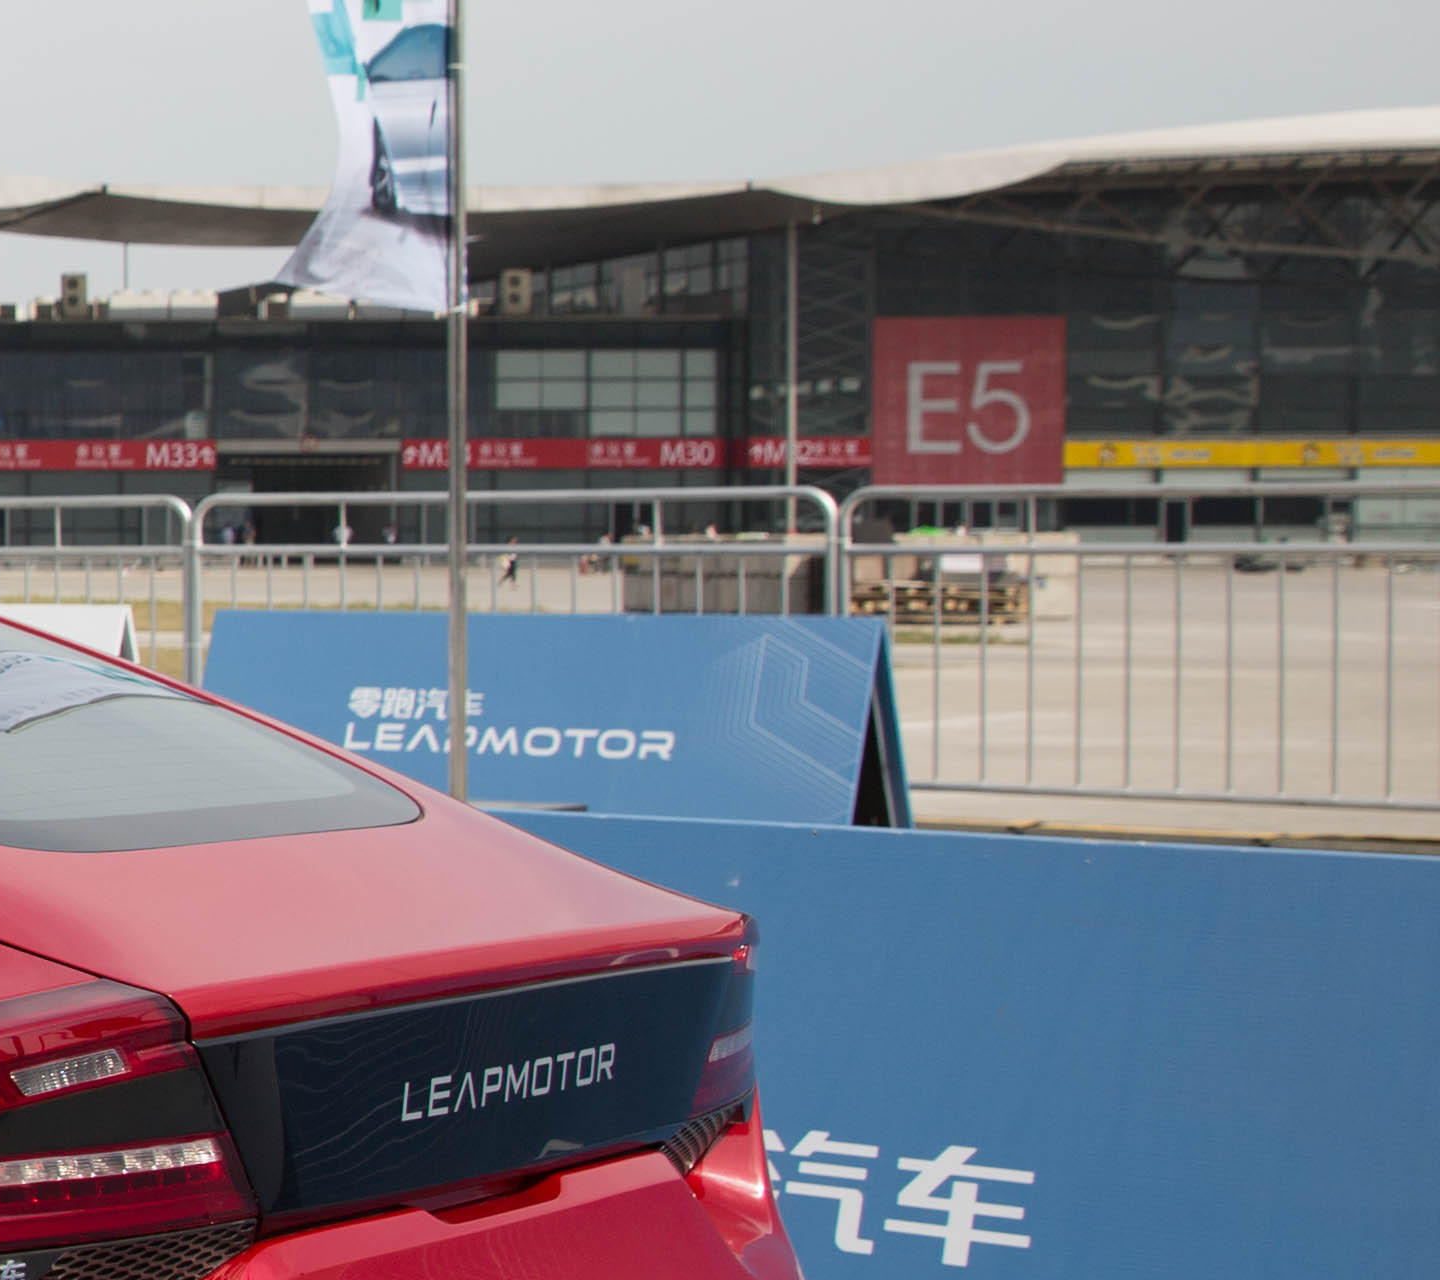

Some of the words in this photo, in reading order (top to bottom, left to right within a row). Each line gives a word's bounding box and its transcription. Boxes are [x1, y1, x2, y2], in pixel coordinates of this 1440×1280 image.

[905, 360, 1032, 456] E5
[144, 442, 200, 468] M33
[660, 439, 716, 467] M30
[401, 1042, 617, 1124] LEAPMOTOR
